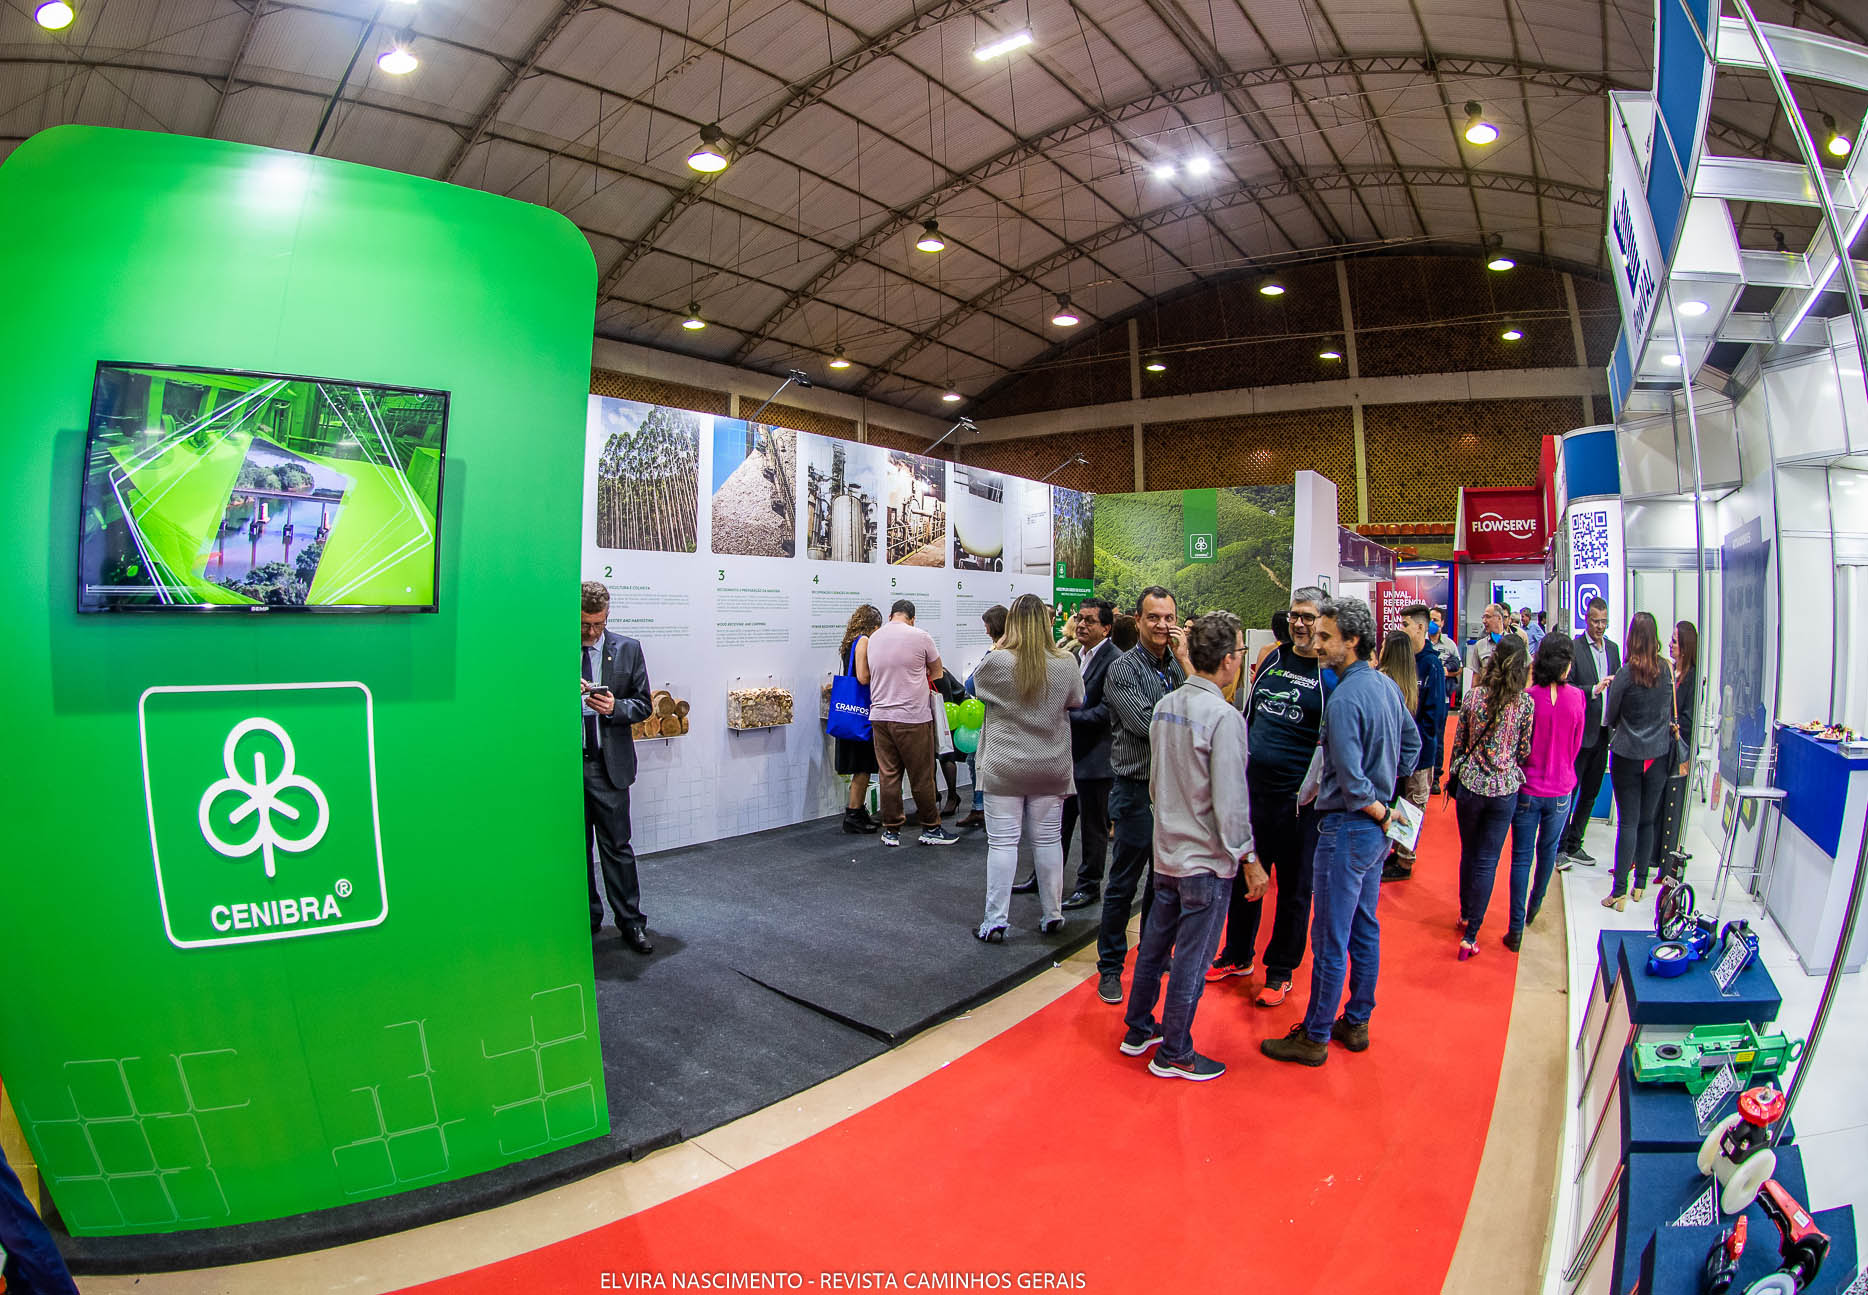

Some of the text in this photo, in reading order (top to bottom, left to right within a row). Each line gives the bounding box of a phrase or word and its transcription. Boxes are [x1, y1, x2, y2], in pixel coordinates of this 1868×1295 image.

[1471, 519, 1537, 533] FLOWSERVE
[604, 565, 613, 578] 2
[718, 569, 725, 581] 3
[812, 574, 820, 585] 4
[891, 577, 897, 587] 5
[957, 581, 963, 590] 6
[1010, 584, 1014, 593] 7
[1282, 670, 1319, 687] Kawasaki
[835, 702, 869, 716] CRANFOS
[210, 895, 342, 931] CENIBRA
